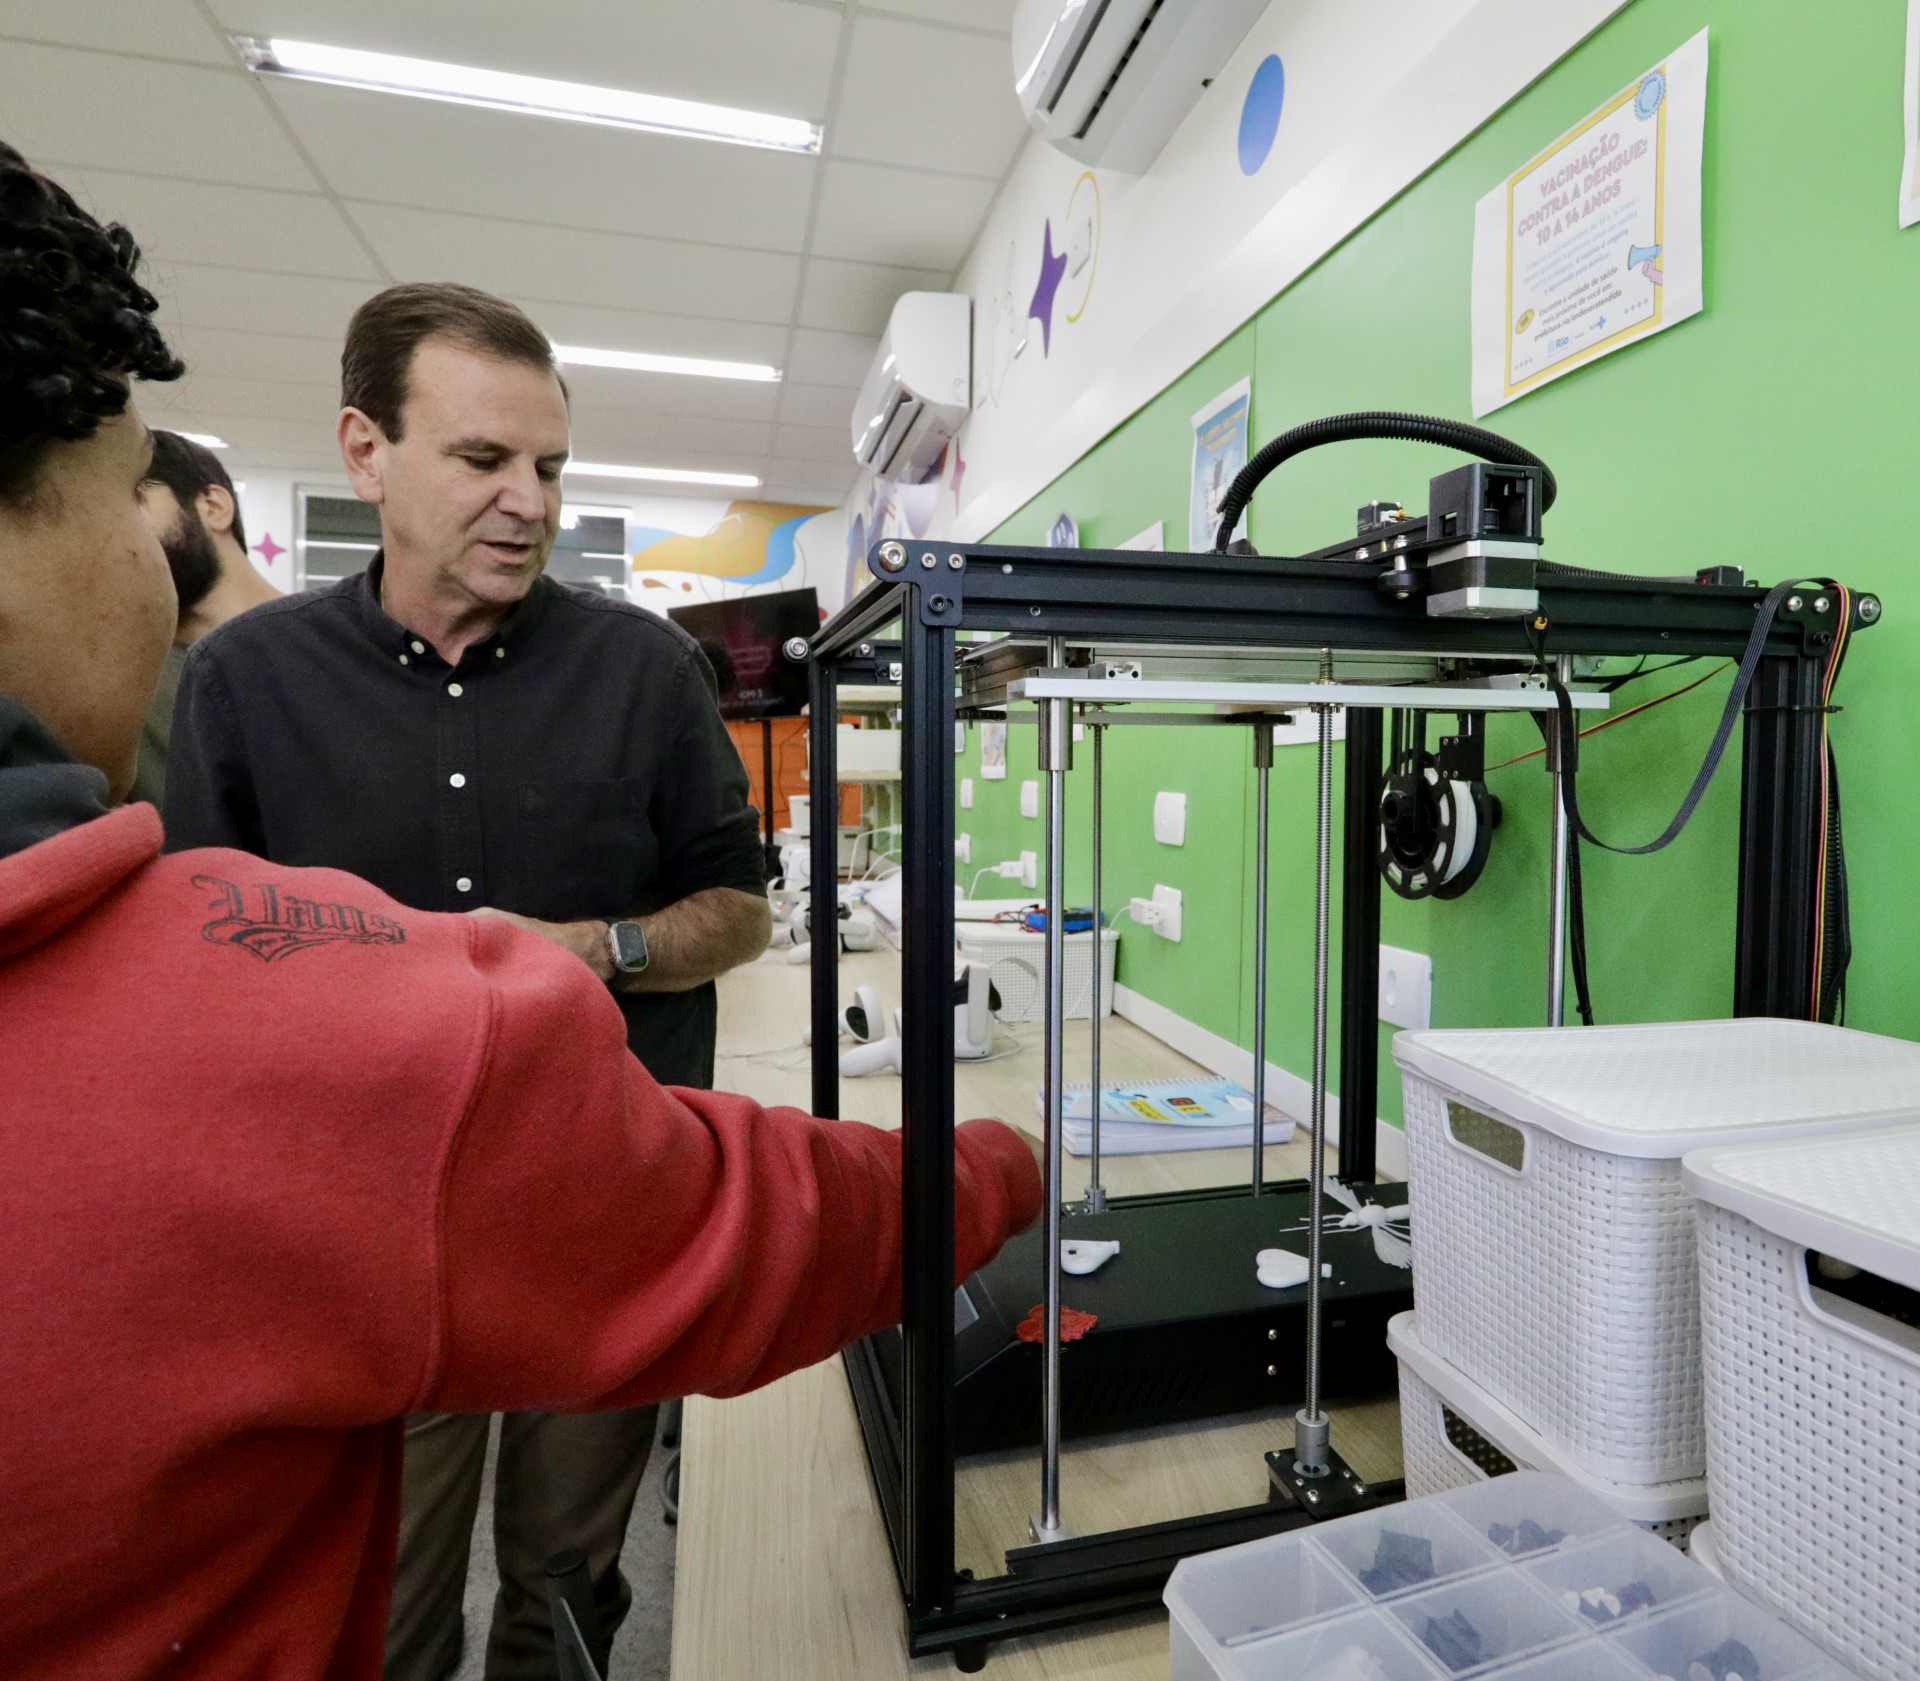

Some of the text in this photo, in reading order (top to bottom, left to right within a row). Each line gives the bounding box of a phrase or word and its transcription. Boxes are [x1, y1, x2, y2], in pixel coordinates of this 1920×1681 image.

[1518, 139, 1647, 237] CONTRA A DENGUE:
[1540, 132, 1620, 198] VACINAÇÃO
[1537, 179, 1621, 246] 10 A 14 ANOS
[1539, 299, 1561, 317] Encontre
[1568, 281, 1590, 301] unidade
[1600, 265, 1618, 281] saúde
[1556, 336, 1569, 349] Rio
